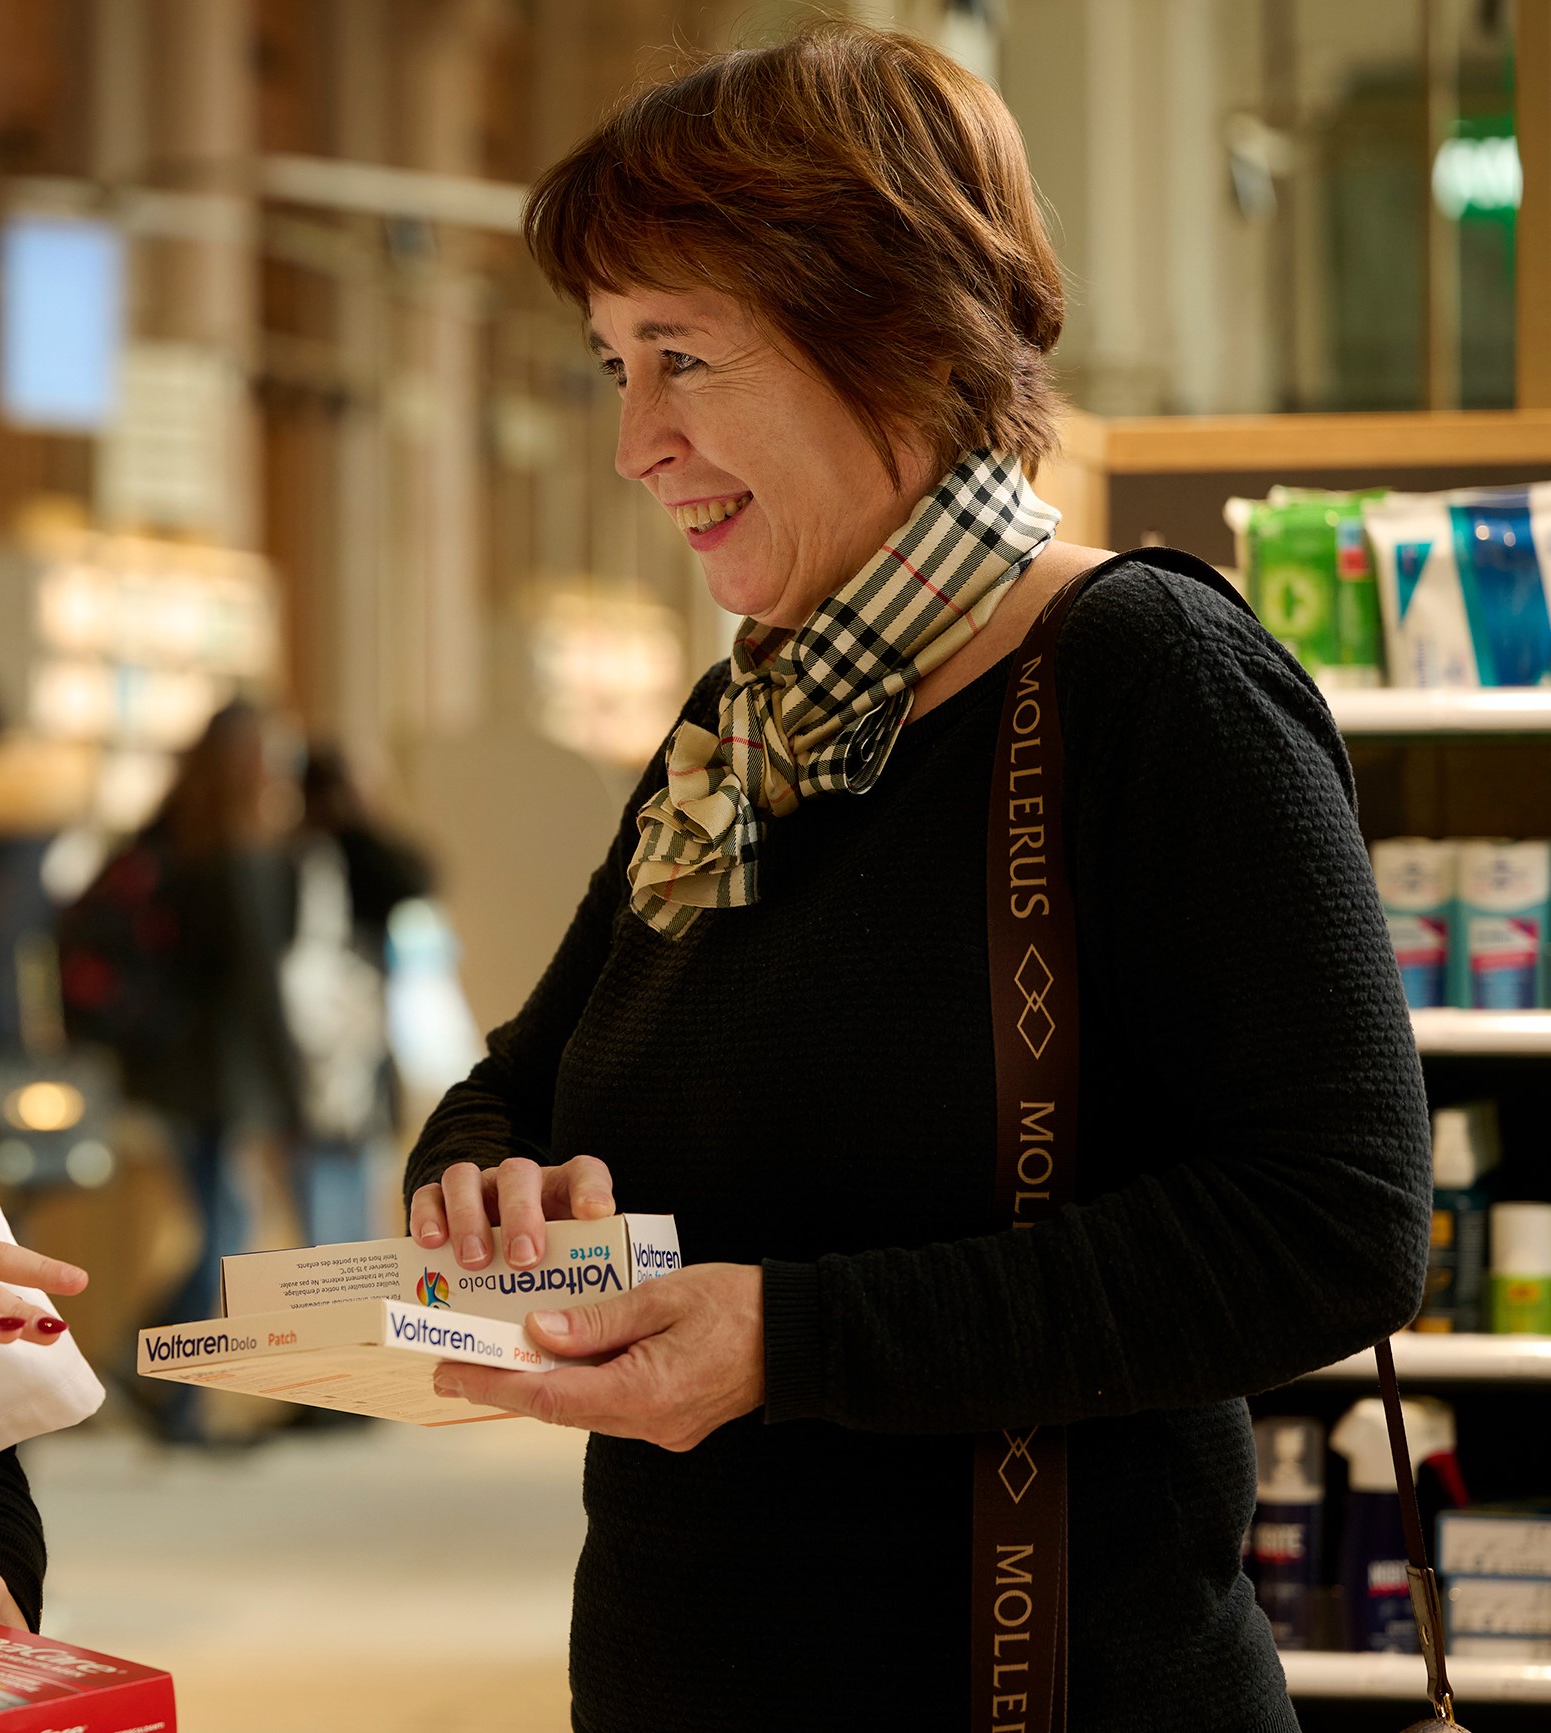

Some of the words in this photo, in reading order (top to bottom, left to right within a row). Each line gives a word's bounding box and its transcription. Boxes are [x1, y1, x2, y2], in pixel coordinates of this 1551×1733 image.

[1009, 654, 1050, 919] MOLLERUS
[569, 1245, 611, 1261] forte
[633, 1242, 681, 1269] Voltaren
[345, 1274, 377, 1282] traitement
[347, 1283, 375, 1291] consulter
[376, 1280, 400, 1288] Veuillez
[459, 1275, 496, 1293] Dolo
[498, 1262, 623, 1295] Voltaren
[145, 1333, 229, 1362] Voltaren
[230, 1338, 257, 1351] Dolo
[268, 1331, 297, 1347] Patch
[390, 1312, 475, 1352] Voltaren
[477, 1340, 503, 1358] Dolo
[513, 1347, 542, 1365] Patch
